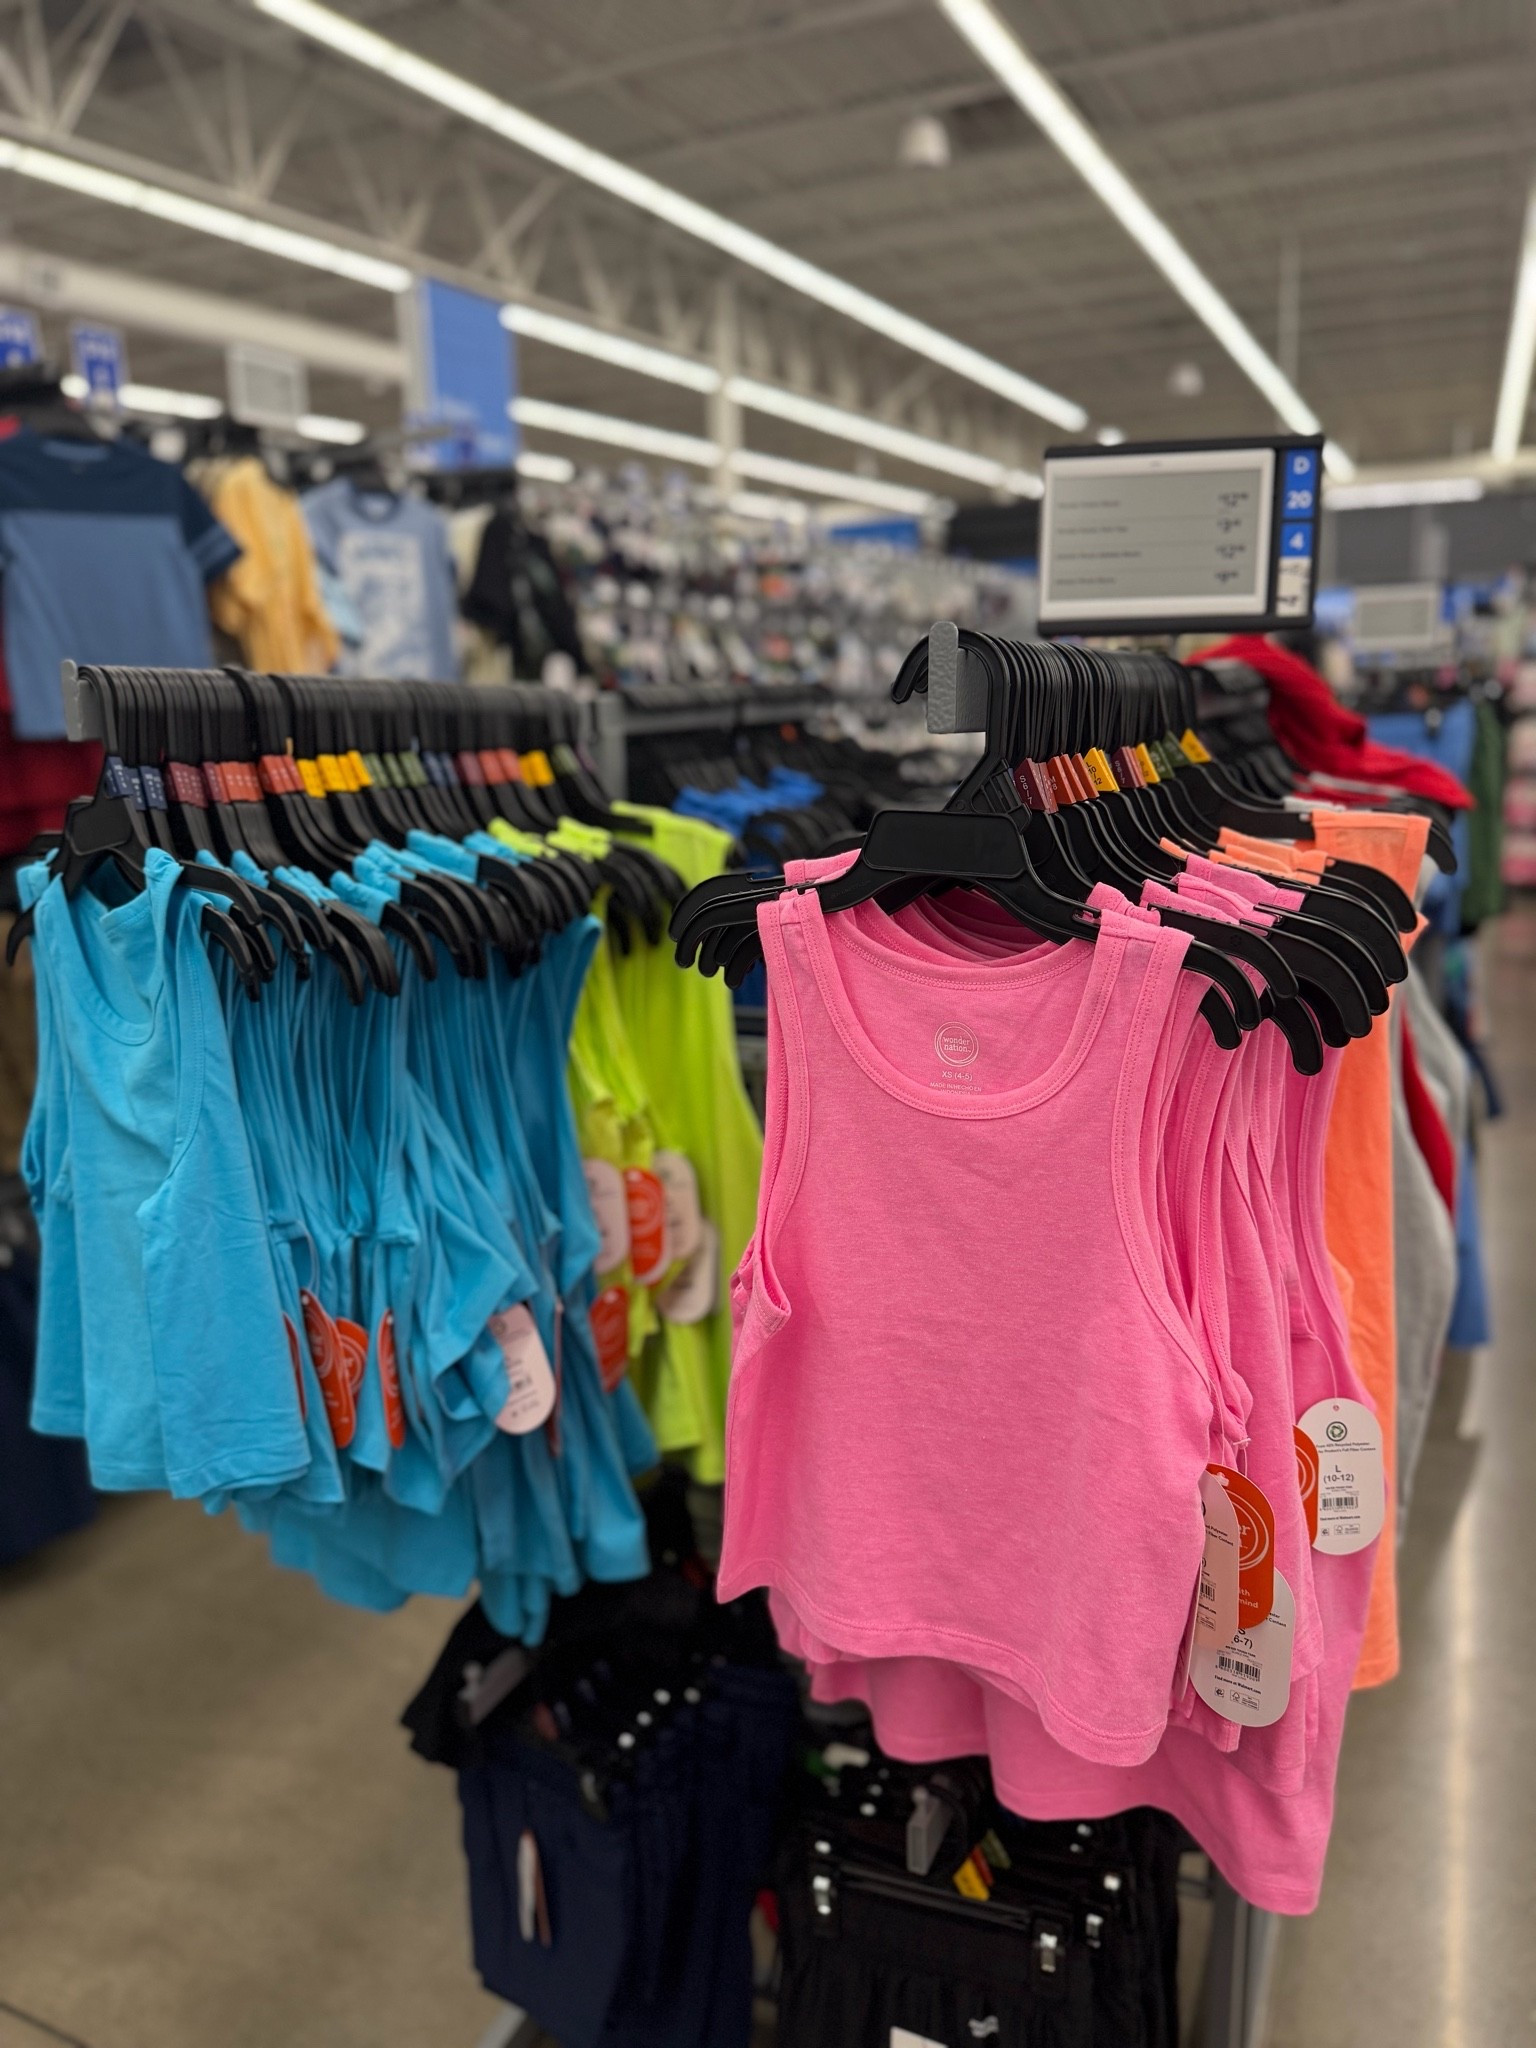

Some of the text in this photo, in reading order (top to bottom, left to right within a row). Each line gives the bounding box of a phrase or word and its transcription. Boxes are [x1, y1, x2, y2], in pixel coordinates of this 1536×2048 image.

[1293, 455, 1311, 475] D
[1287, 489, 1313, 510] 20
[1289, 531, 1304, 550] 4
[943, 1036, 970, 1046] wonder
[954, 1072, 973, 1081] (4-5)
[1335, 1465, 1342, 1473] L
[1323, 1473, 1355, 1485] (10-12)
